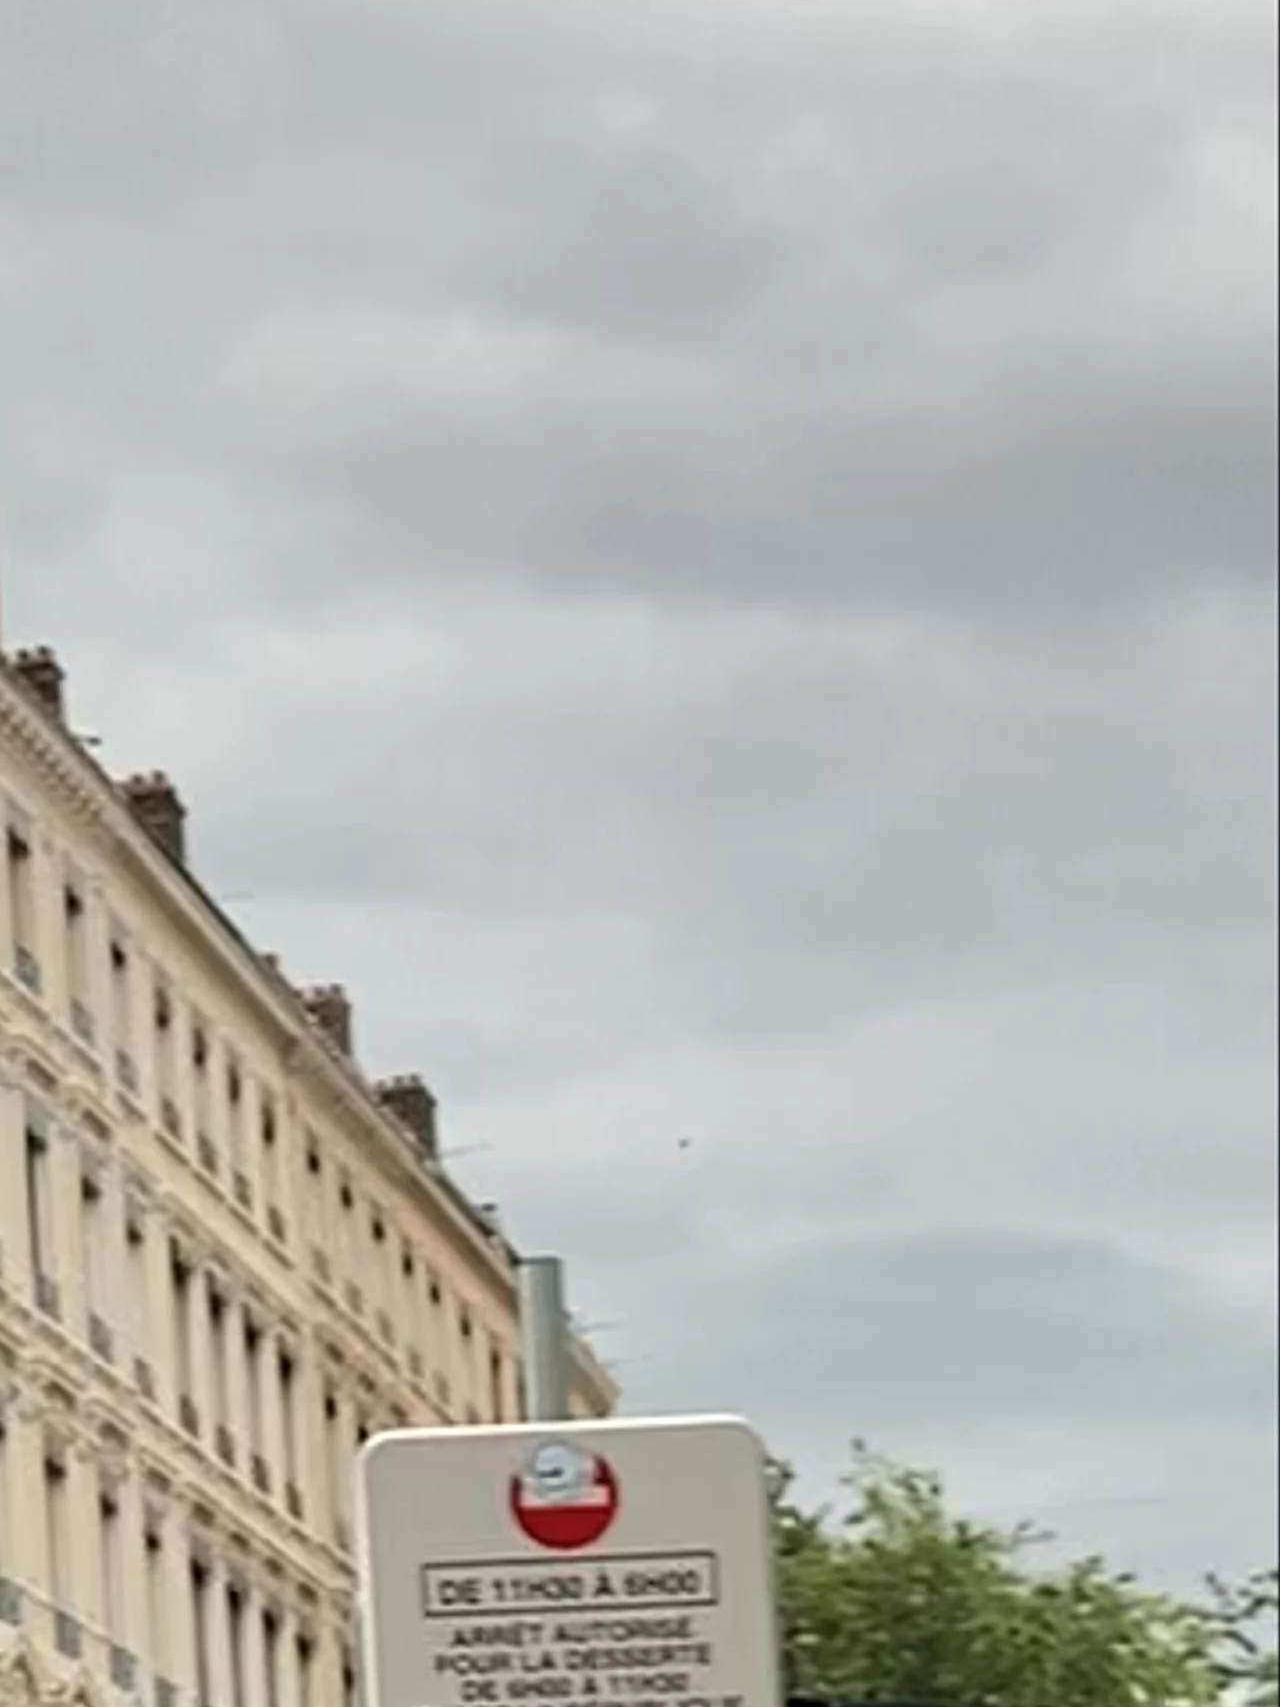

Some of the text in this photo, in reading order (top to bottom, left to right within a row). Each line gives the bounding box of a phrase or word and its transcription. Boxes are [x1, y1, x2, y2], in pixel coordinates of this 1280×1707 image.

[438, 1577, 482, 1605] DE
[435, 1651, 512, 1676] POUR
[522, 1649, 557, 1673] LA
[460, 1679, 498, 1703] DE
